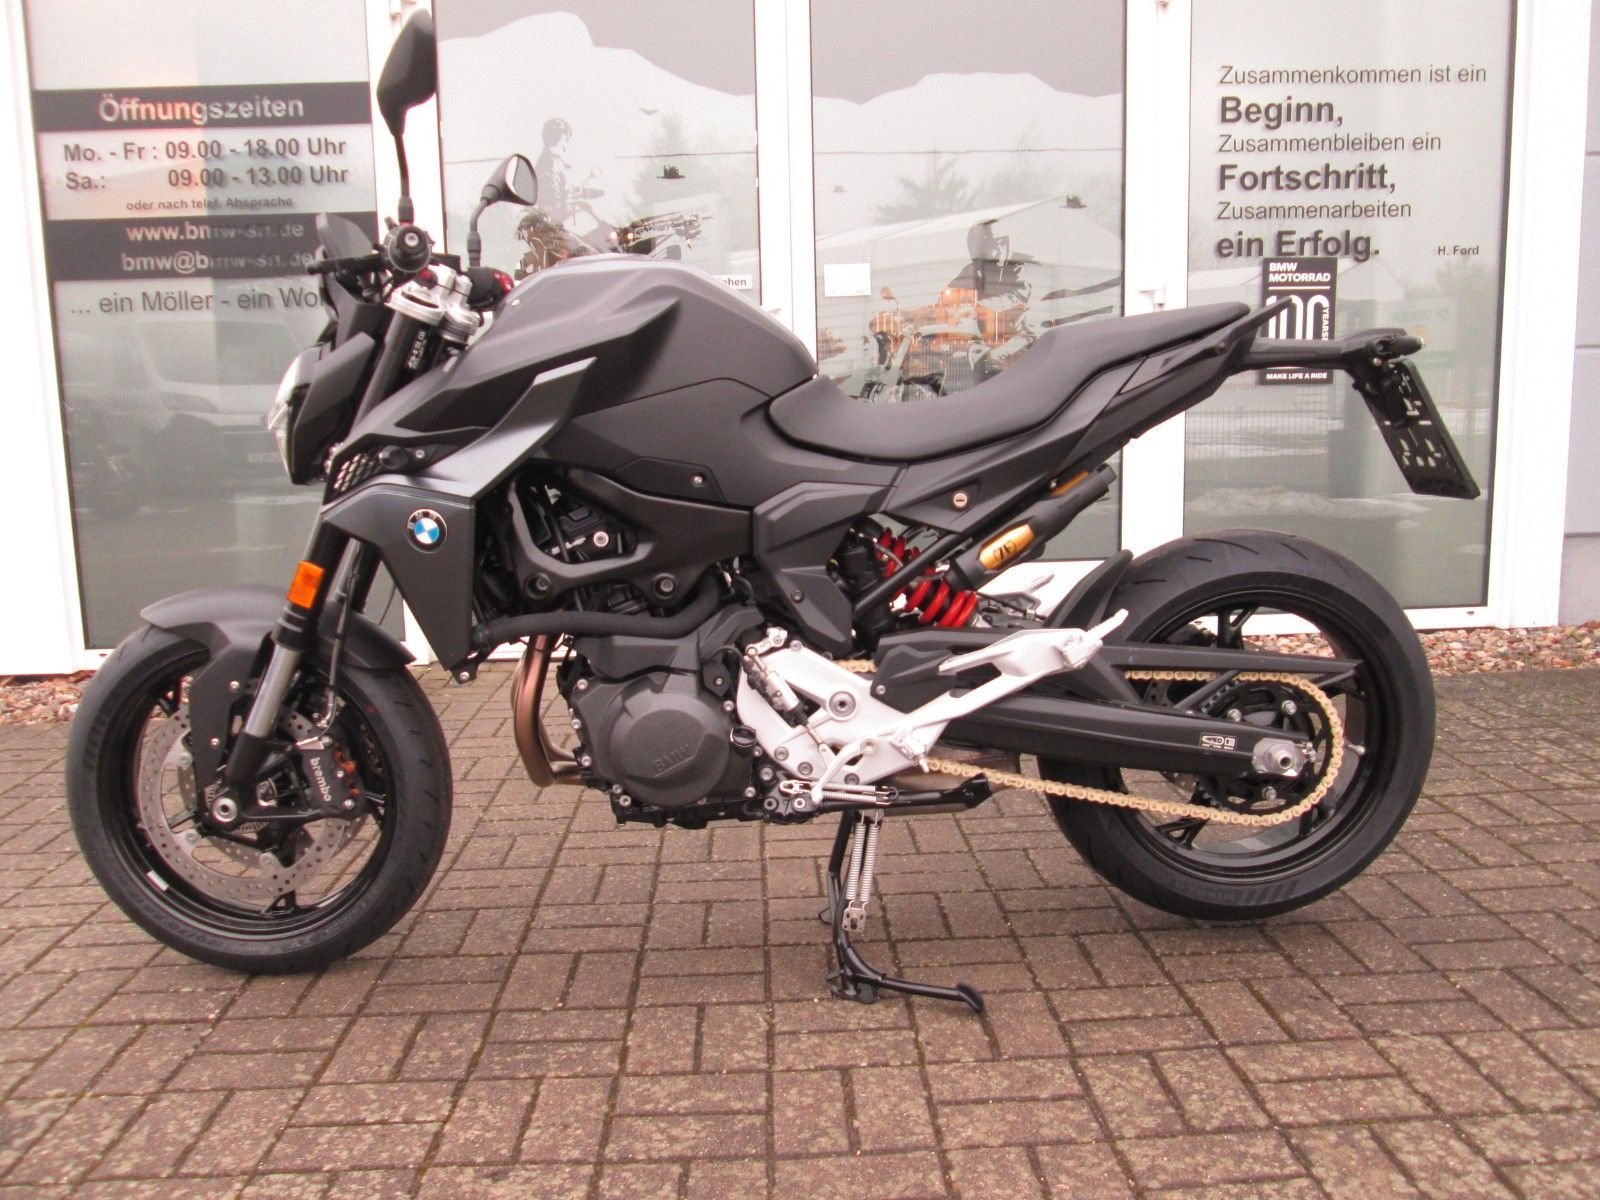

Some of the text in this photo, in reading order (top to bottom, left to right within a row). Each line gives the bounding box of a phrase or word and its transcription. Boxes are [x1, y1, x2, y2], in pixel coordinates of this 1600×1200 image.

[1219, 65, 1487, 85] Zusammenkommen ist ein
[99, 93, 304, 126] Öffnungszeiten
[1220, 96, 1343, 129] Beginn,
[64, 144, 101, 162] Mo.
[165, 140, 222, 160] 09.00
[244, 138, 300, 157] 18.00
[308, 137, 347, 155] Uhr
[1219, 133, 1441, 153] Zusammenbleiben ein
[66, 171, 106, 190] Sa.:
[168, 168, 224, 187] 09.00
[246, 166, 302, 185] 13.00
[310, 165, 348, 184] Uhr
[1219, 163, 1396, 193] Fortschritt,
[126, 200, 154, 211] oder
[158, 199, 188, 210] nach
[1217, 201, 1412, 220] Zusammenarbeiten
[1216, 229, 1380, 262] ein Erfolg.
[1437, 245, 1480, 256] H. Ford
[1268, 262, 1298, 272] BMW
[1268, 273, 1331, 282] MOTORRAD
[100, 293, 133, 313] ein
[142, 291, 213, 312] Möller
[237, 290, 272, 309] ein
[310, 757, 332, 802] brembo
